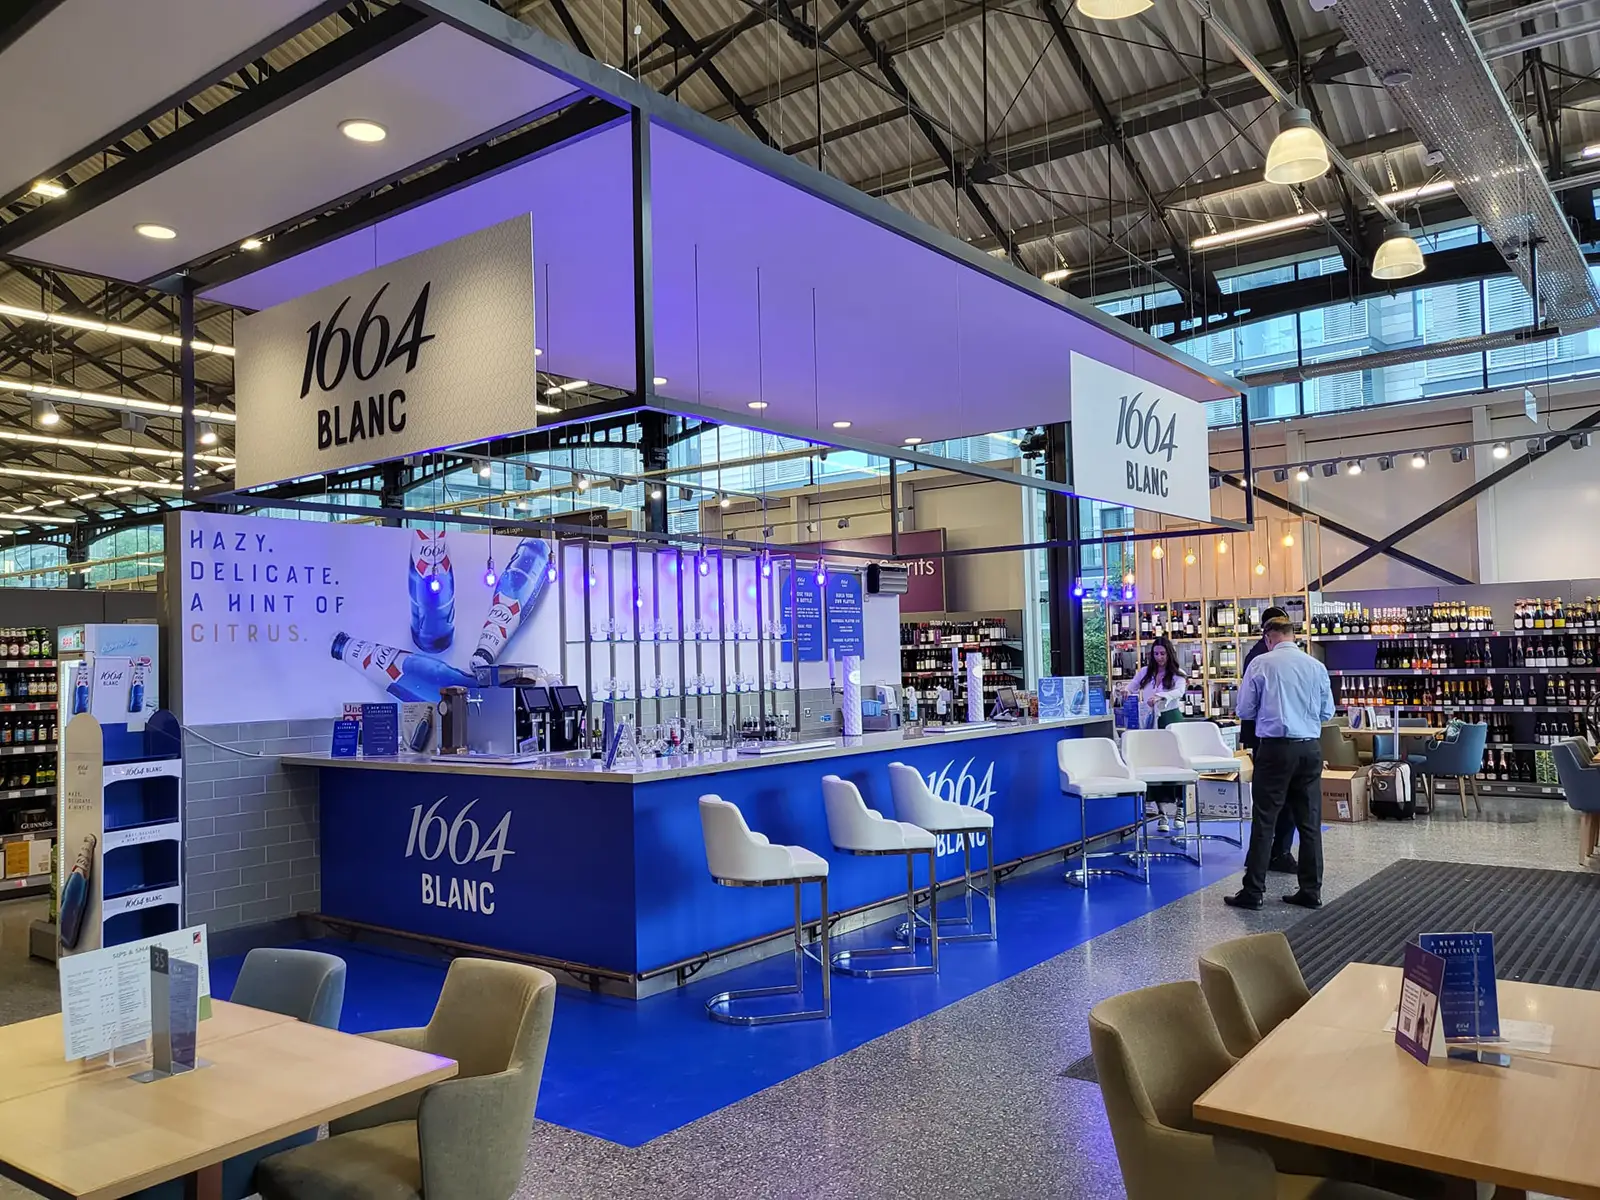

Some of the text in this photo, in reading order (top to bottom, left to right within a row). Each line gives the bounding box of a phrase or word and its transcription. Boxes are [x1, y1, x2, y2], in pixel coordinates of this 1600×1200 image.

[300, 281, 435, 399] 1664
[317, 389, 406, 450] BLANC
[1116, 392, 1178, 462] 1664
[1126, 460, 1168, 498] BLANC
[190, 529, 273, 553] HAZY.
[190, 561, 339, 585] DELICATE.
[190, 592, 345, 614] A HINT OF
[190, 623, 308, 643] CITRUS.
[926, 756, 997, 812] 1664
[20, 820, 53, 830] GUINNESS
[404, 795, 516, 873] 1664
[421, 873, 495, 915] BLANC
